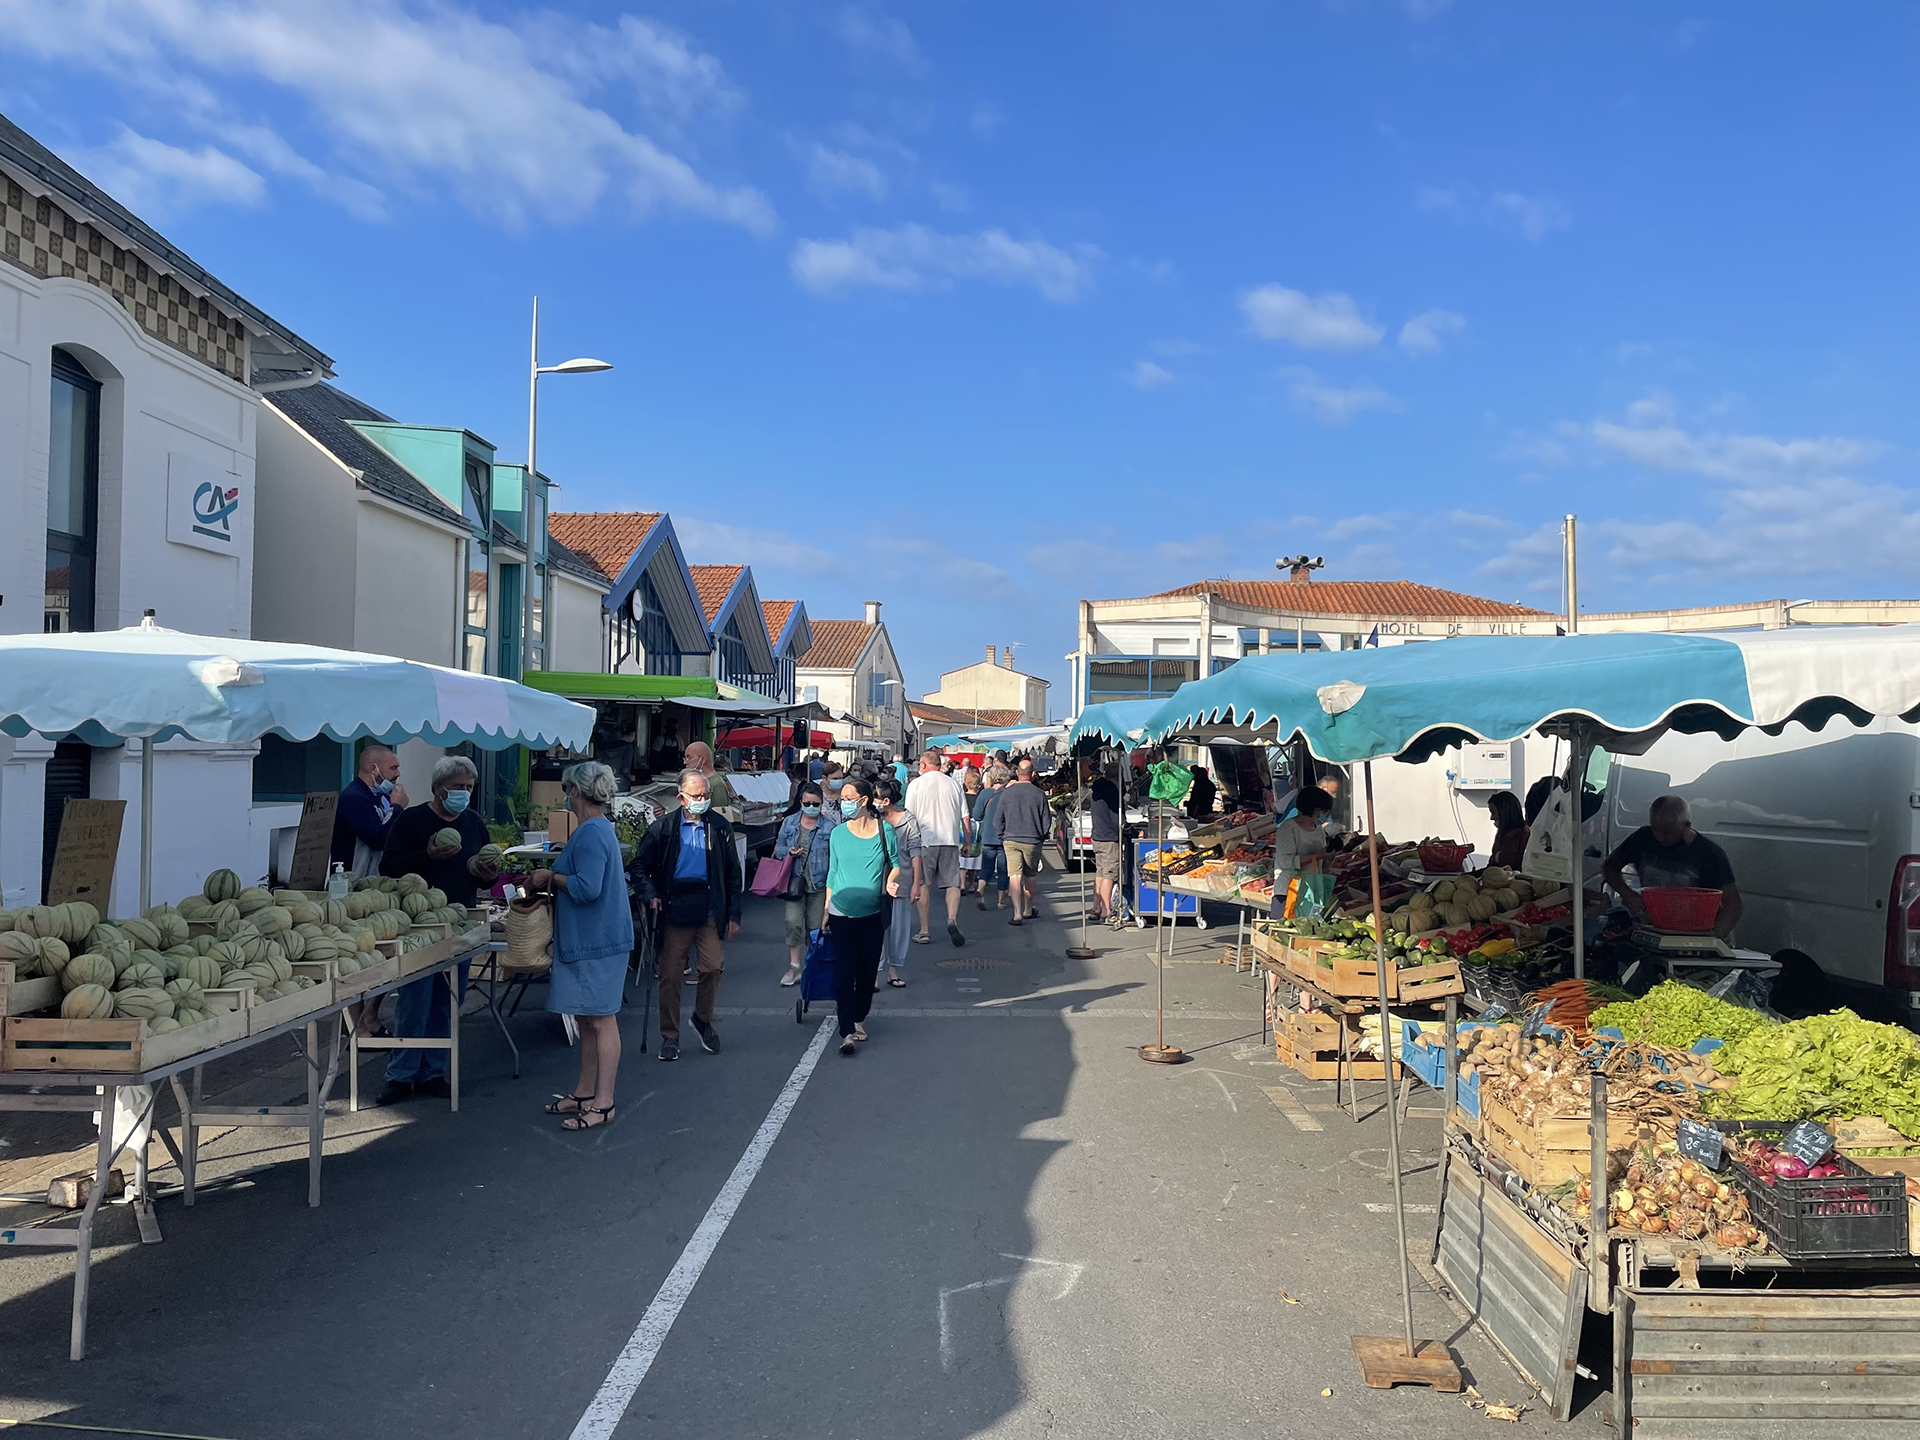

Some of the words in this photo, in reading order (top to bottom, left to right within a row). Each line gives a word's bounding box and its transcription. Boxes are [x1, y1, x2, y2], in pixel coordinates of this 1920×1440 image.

[1381, 621, 1424, 635] HOTEL
[1447, 622, 1464, 635] DE
[1488, 622, 1528, 635] VILLE
